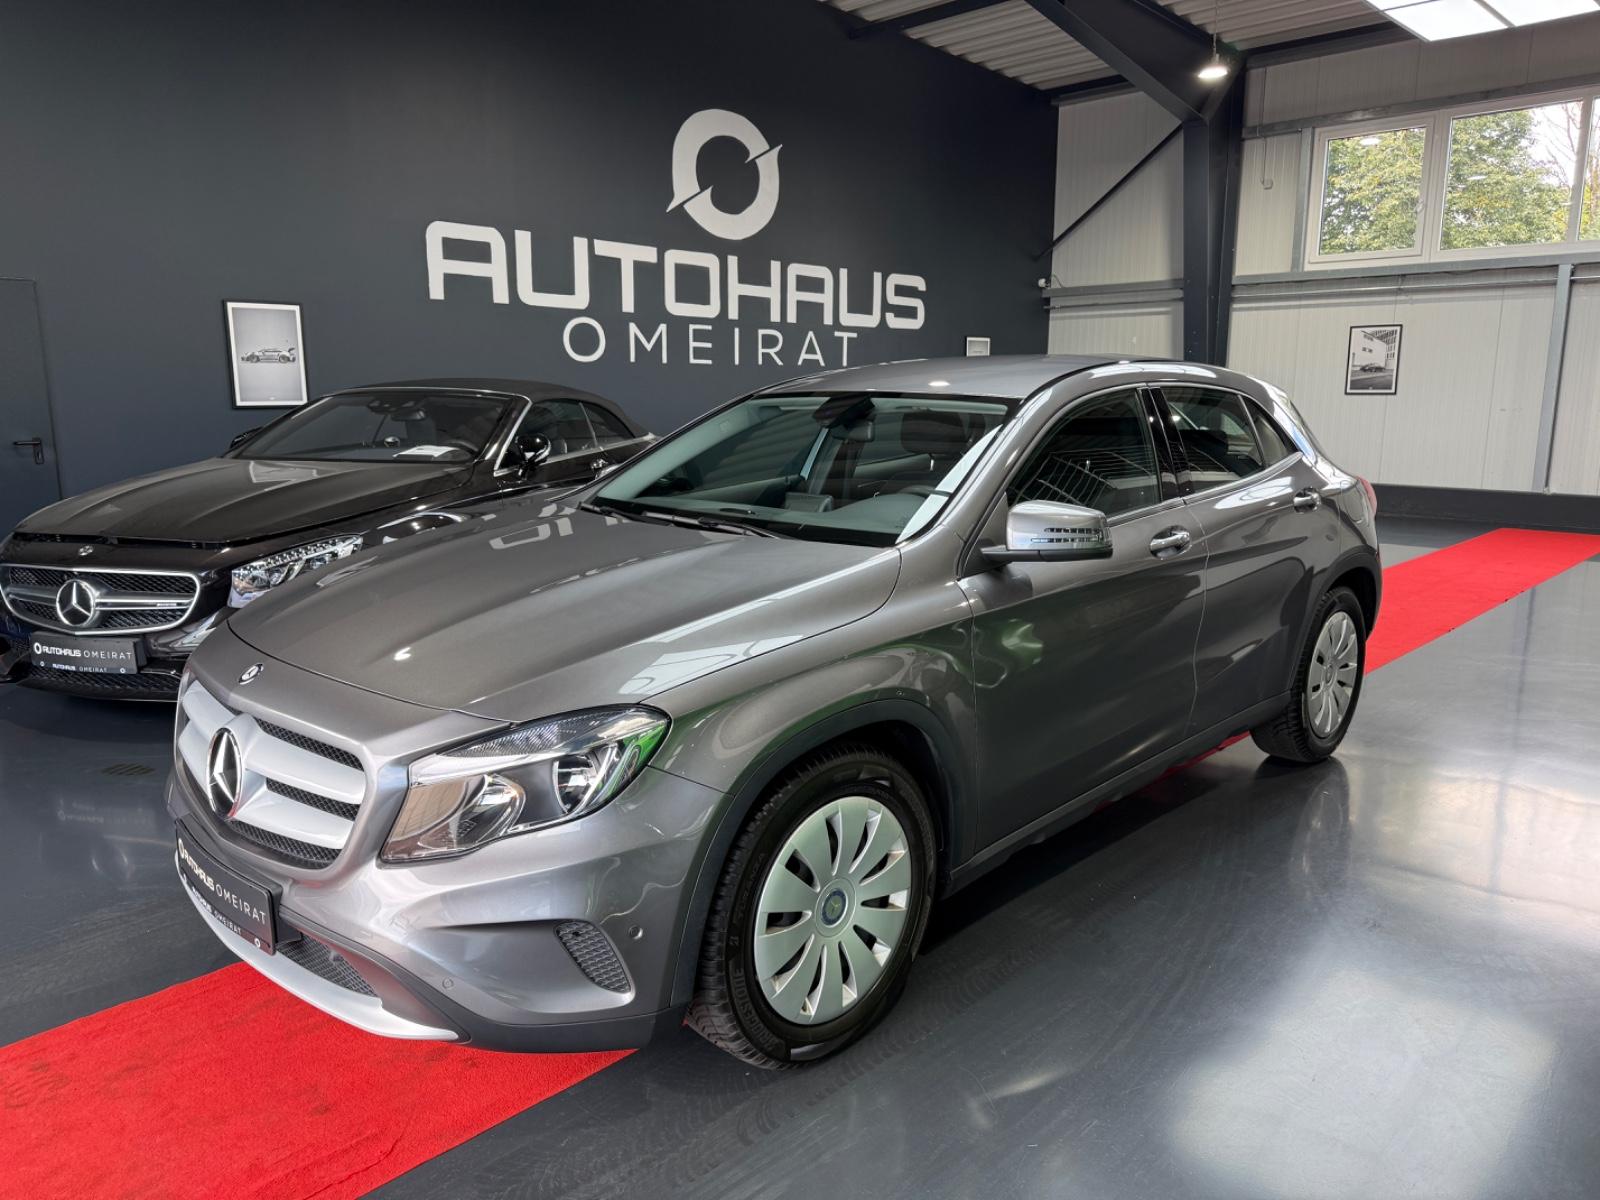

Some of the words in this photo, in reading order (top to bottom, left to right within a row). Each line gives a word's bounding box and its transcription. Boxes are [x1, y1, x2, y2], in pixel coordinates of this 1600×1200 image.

[425, 220, 926, 330] AUTOHAUS
[562, 315, 857, 367] OMEIRAT
[42, 645, 81, 657] AUTOHAUS
[83, 649, 132, 660] OMEIRAT
[184, 849, 215, 892] AUTOHAUS
[215, 884, 267, 925] OMEIRAT
